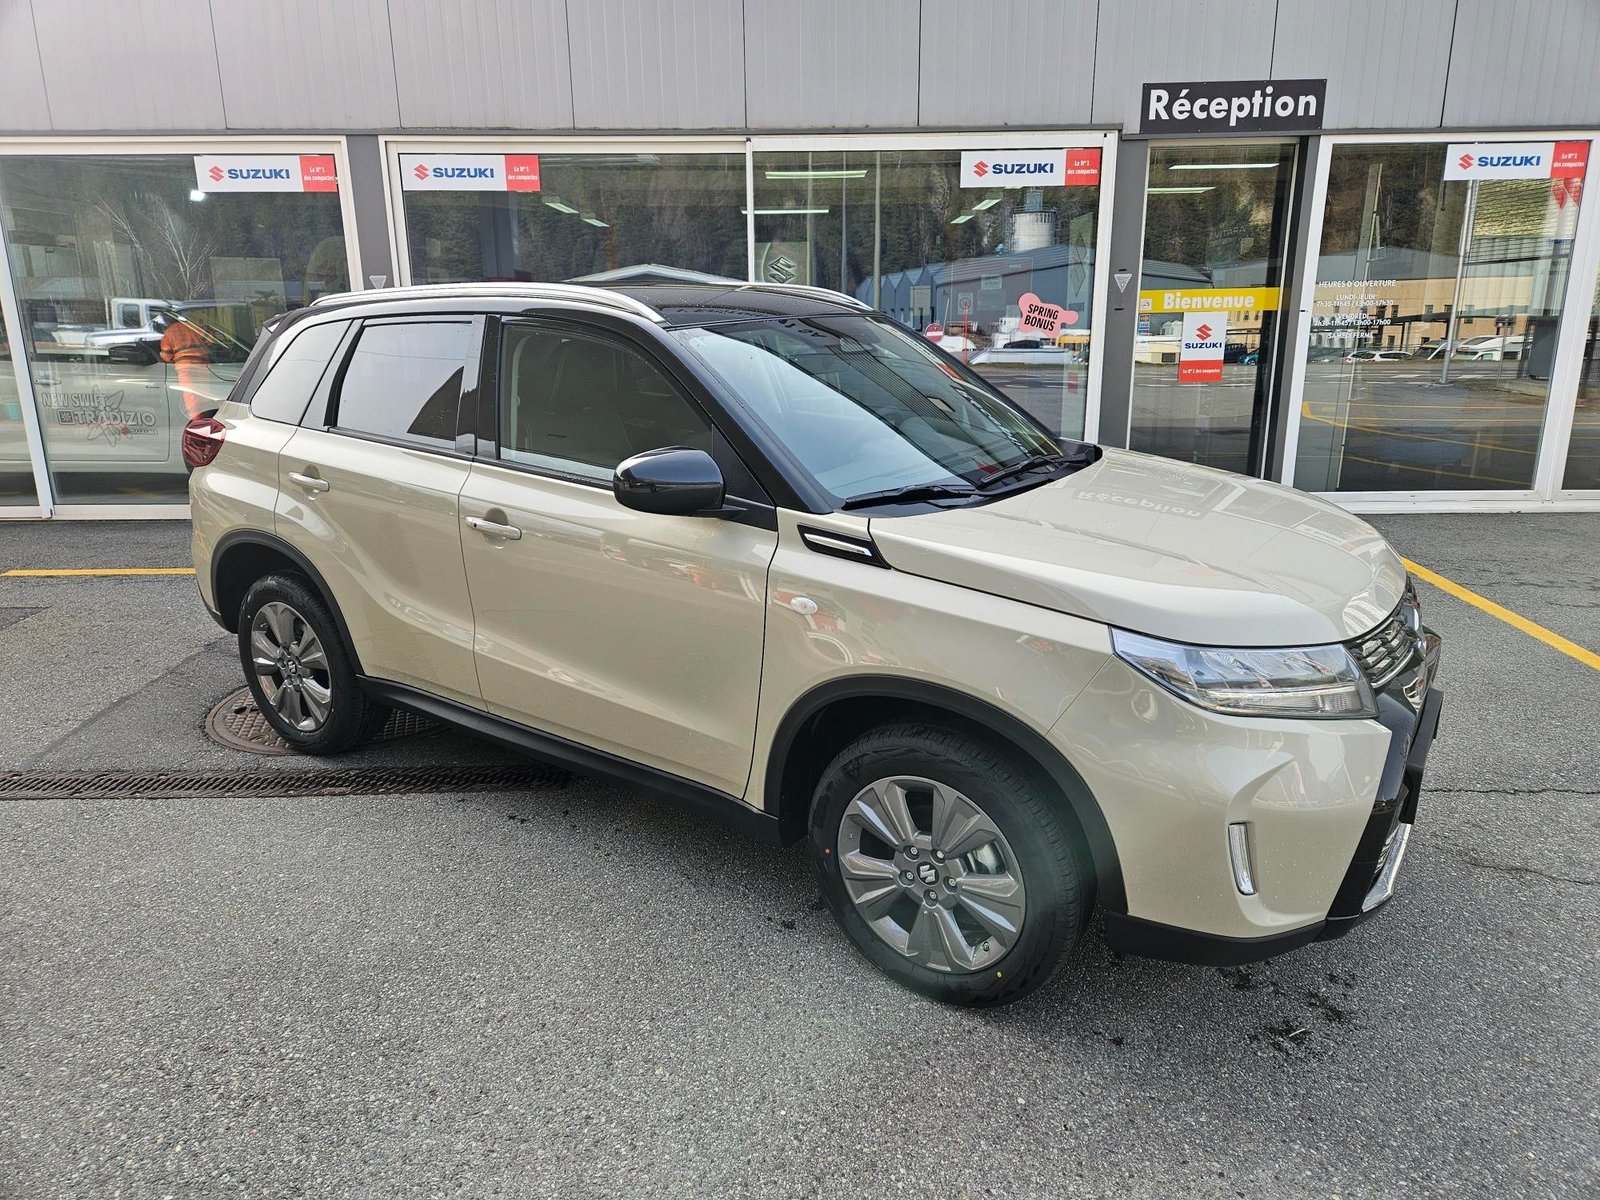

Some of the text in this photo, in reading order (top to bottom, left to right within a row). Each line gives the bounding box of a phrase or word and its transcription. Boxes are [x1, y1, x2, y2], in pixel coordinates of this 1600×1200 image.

[1148, 85, 1317, 127] Réception
[1477, 155, 1541, 167] SUZUKI
[227, 168, 291, 180] SUZUKI
[432, 167, 495, 179] SUZUKI
[992, 163, 1054, 174] SUZUKI
[1075, 168, 1098, 176] compactes
[1318, 279, 1397, 288] HEURES D'OUVERTURE
[1163, 291, 1255, 310] Bienvenue
[1027, 303, 1059, 320] SPRING
[1024, 314, 1056, 332] BONUS
[41, 392, 107, 408] NEW SWIFT
[74, 409, 156, 427] TRADIZIO
